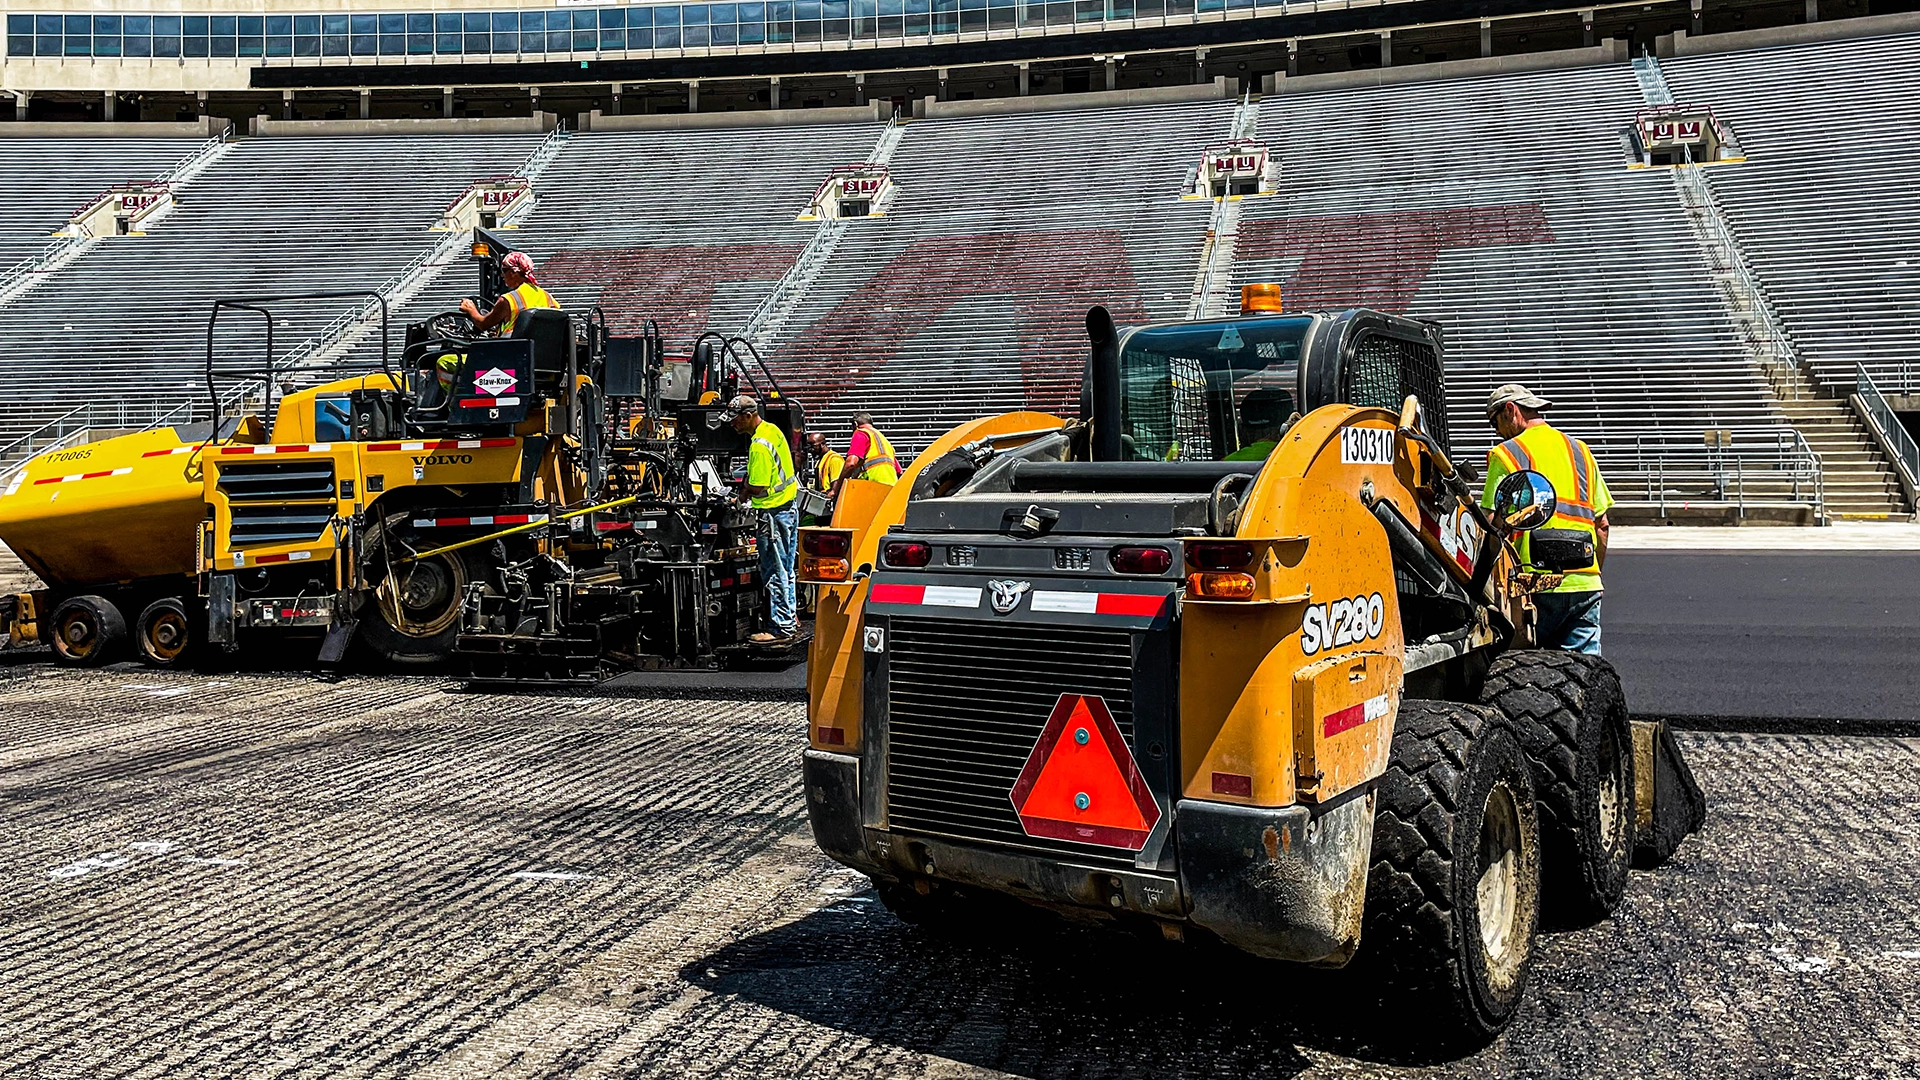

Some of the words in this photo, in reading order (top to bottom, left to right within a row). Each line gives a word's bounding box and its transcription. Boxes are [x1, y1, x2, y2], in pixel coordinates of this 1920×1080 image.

[1659, 125, 1667, 135] U
[1685, 122, 1694, 133] V
[1221, 158, 1229, 168] T
[1242, 157, 1250, 167] U
[847, 180, 855, 190] S
[866, 180, 873, 189] T
[126, 196, 134, 206] Q
[488, 192, 495, 202] R
[506, 192, 514, 201] S
[478, 378, 512, 386] Blaw-Knox
[1342, 428, 1393, 463] 130310
[46, 449, 93, 463] 170065
[411, 454, 473, 465] VOLVO
[1301, 592, 1384, 656] SV280
